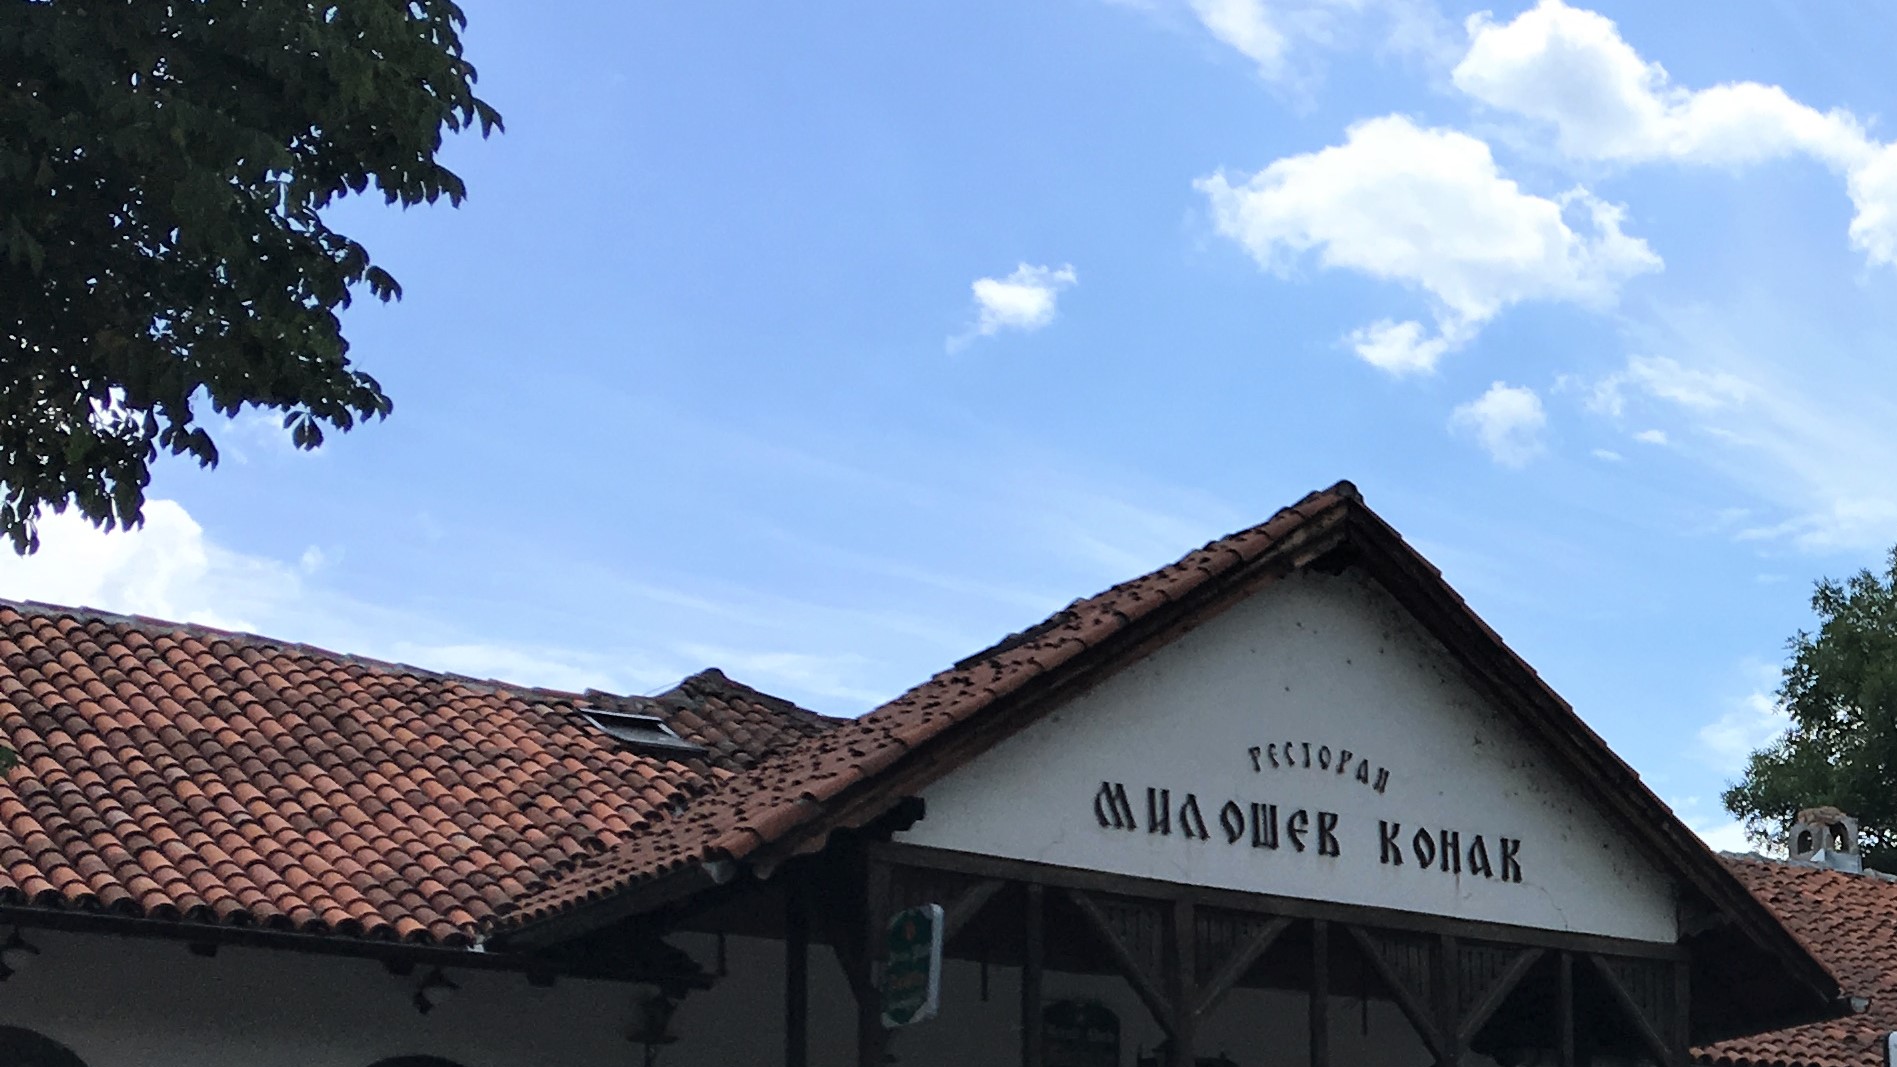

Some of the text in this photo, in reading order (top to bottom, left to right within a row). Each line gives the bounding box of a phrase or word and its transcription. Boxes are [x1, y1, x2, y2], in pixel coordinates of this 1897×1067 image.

[1248, 741, 1389, 794] РЕСТОРАН
[1095, 781, 1523, 883] МИЛОШЕВ КОНАК
